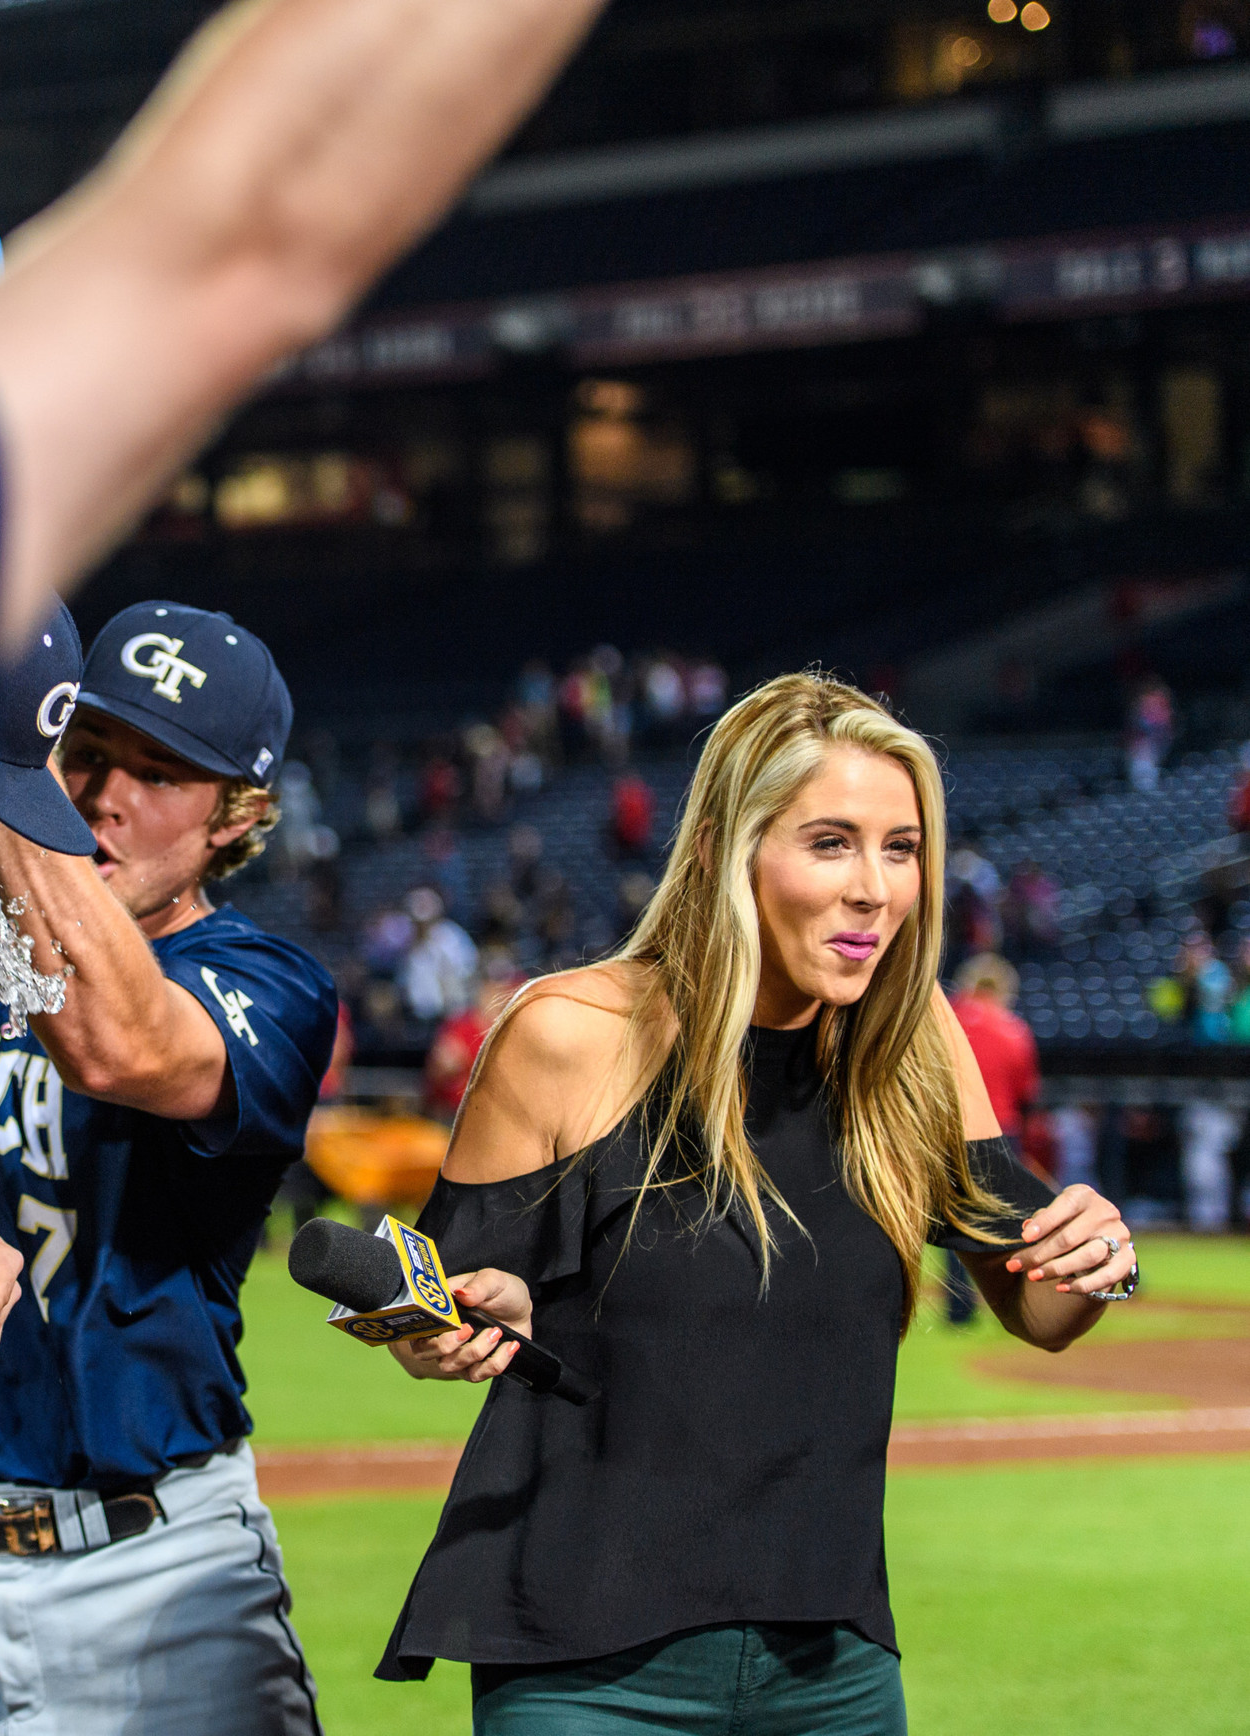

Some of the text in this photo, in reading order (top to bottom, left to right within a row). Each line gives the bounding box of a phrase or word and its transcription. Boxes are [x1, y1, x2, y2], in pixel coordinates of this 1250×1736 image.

[120, 632, 207, 702] GT
[16, 1193, 77, 1324] 7
[404, 1232, 424, 1271] ESPN
[416, 1239, 436, 1278] NETWORK
[416, 1273, 447, 1309] SEC
[352, 1320, 395, 1339] SEC
[385, 1313, 426, 1326] ESPN
